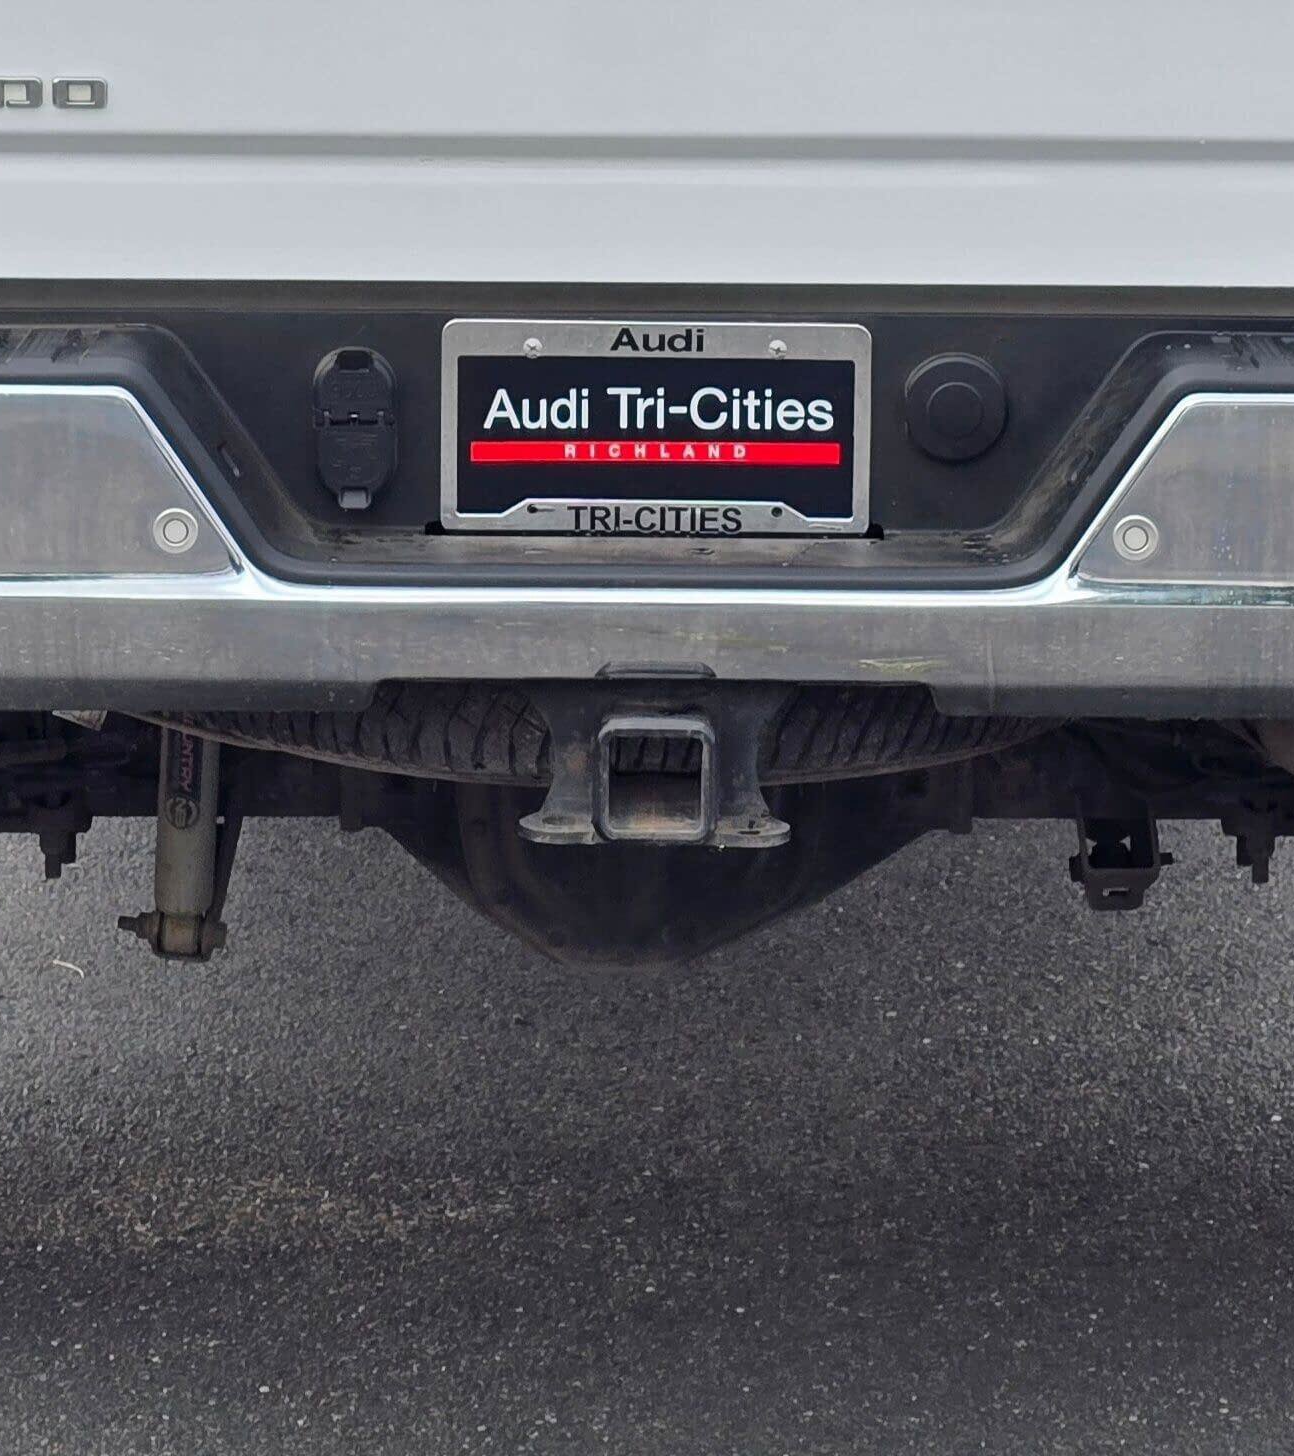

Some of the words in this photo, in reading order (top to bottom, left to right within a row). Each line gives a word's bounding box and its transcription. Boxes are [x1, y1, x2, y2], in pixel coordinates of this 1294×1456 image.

[610, 327, 705, 353] Audi
[482, 387, 590, 431] Audi
[606, 386, 835, 432] Tri-Cities
[563, 444, 747, 460] RICHLAND
[566, 505, 743, 535] TRI-CITIES
